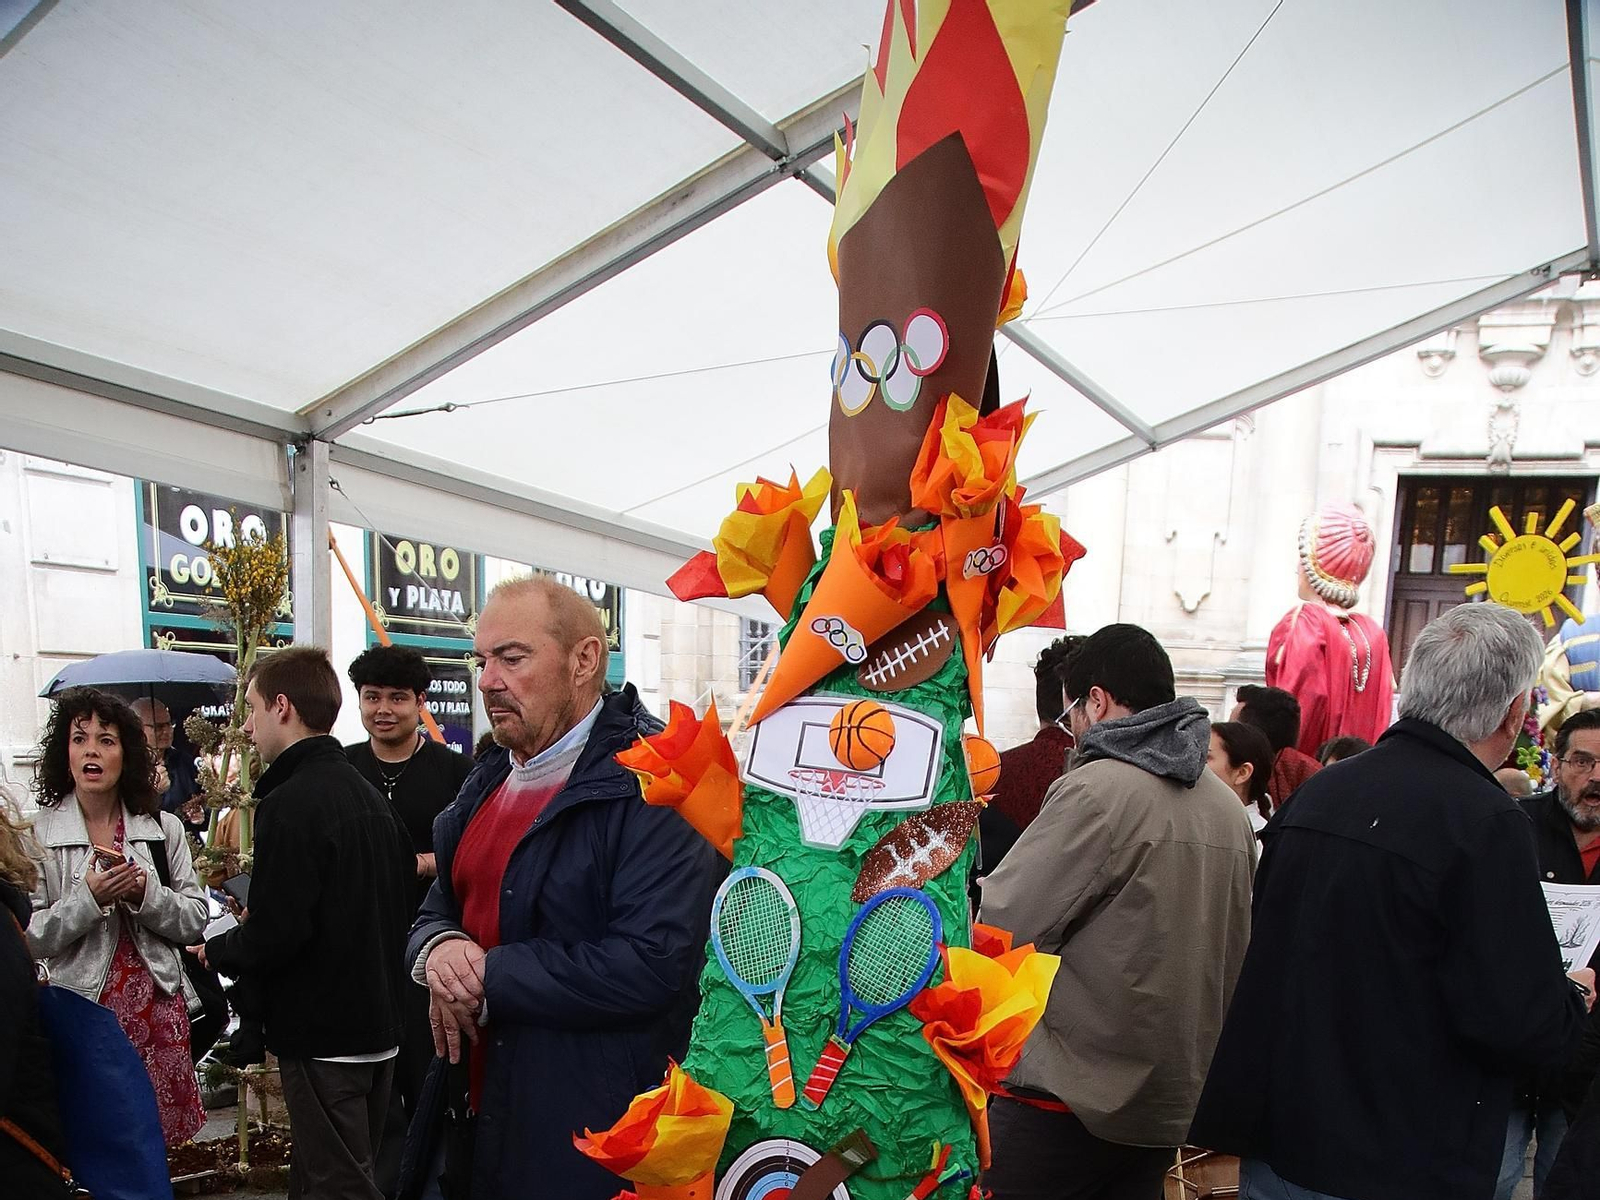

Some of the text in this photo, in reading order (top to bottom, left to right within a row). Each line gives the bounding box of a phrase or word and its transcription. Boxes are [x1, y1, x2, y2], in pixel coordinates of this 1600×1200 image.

[180, 504, 267, 550] ORO
[395, 540, 460, 580] ORO
[388, 584, 465, 614] Y PLATA
[442, 680, 467, 694] TODO
[440, 701, 446, 713] Y
[446, 701, 471, 714] PLATA
